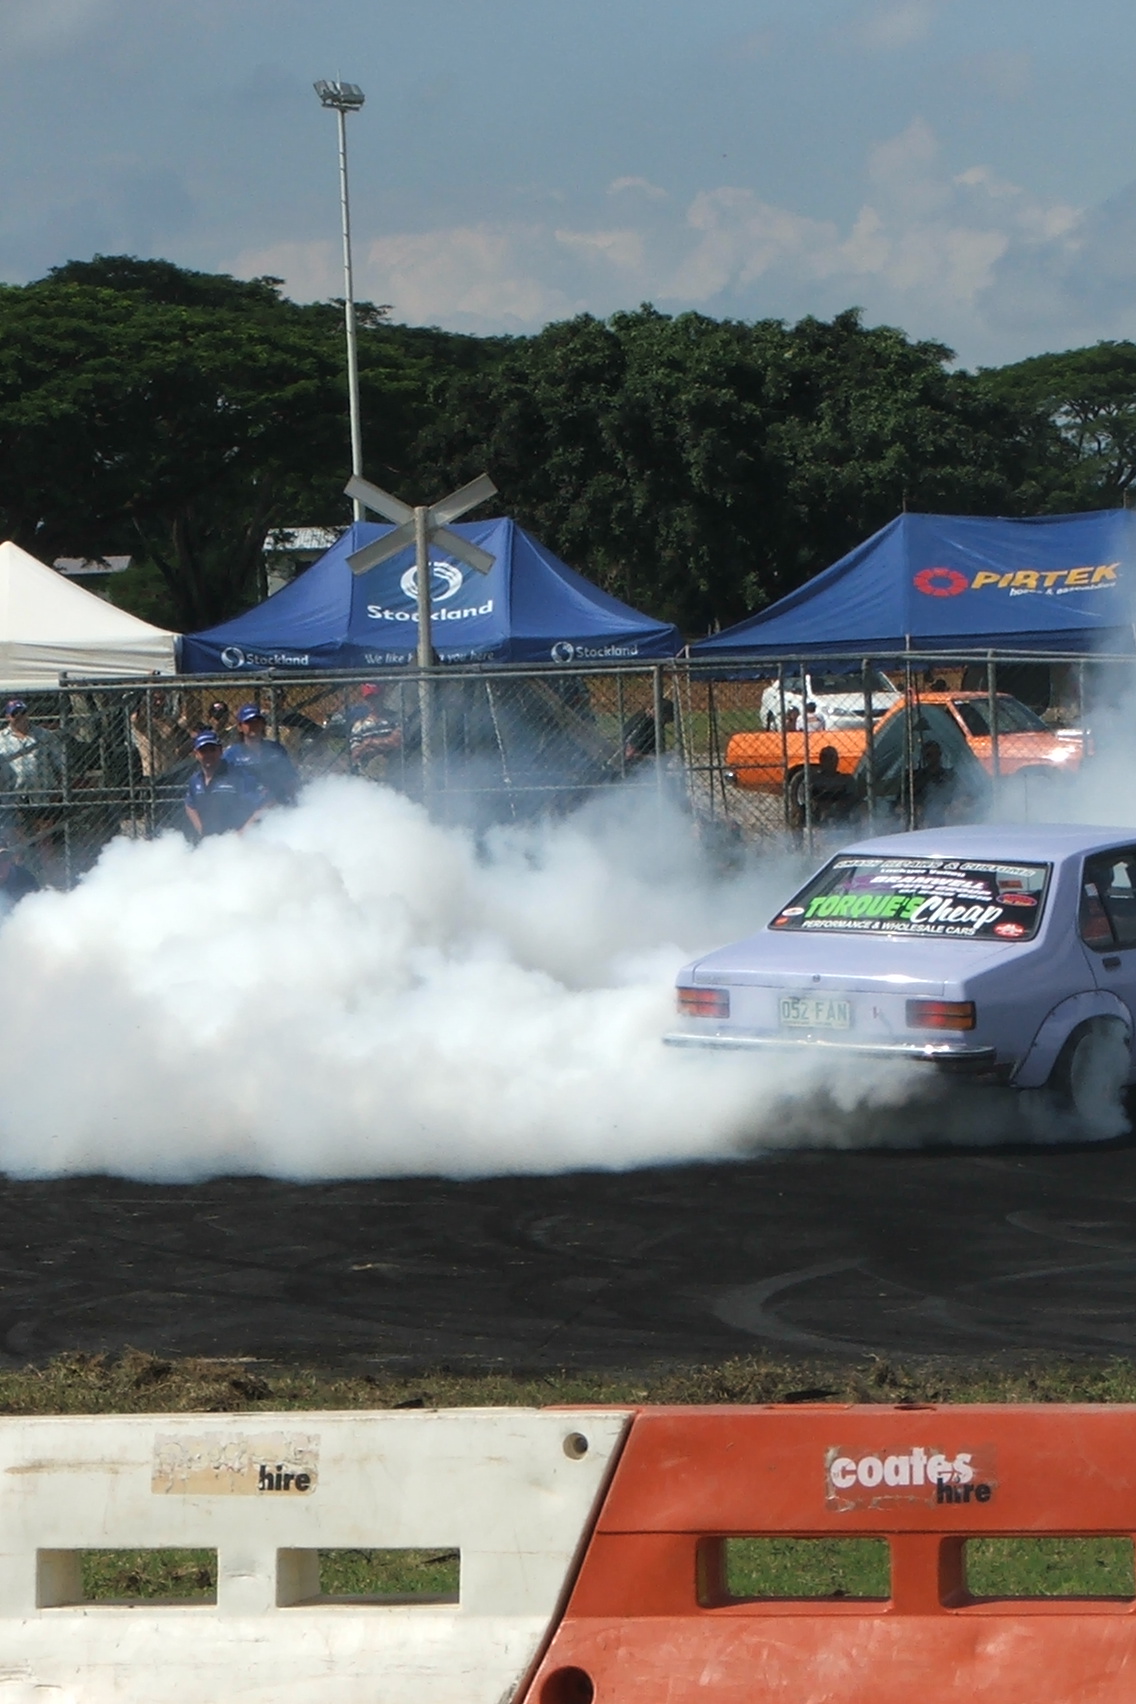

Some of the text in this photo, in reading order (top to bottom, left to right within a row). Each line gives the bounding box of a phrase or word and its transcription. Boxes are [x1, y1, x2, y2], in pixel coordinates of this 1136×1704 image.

[971, 562, 1122, 589] PIRTEK
[246, 653, 309, 667] Stockland
[365, 653, 383, 665] We
[385, 652, 404, 664] like
[469, 649, 494, 662] here
[576, 645, 638, 658] Stockland
[943, 861, 960, 870] &
[870, 876, 985, 890] BRAMWELL
[805, 895, 926, 919] TORQUE'S
[910, 895, 1003, 930] Cheap
[802, 920, 975, 936] PERFORMANCE & WHOLESALE CARS
[815, 1001, 848, 1021] FAN
[258, 1464, 311, 1491] hire
[830, 1447, 974, 1488] coates
[936, 1477, 991, 1504] hire
